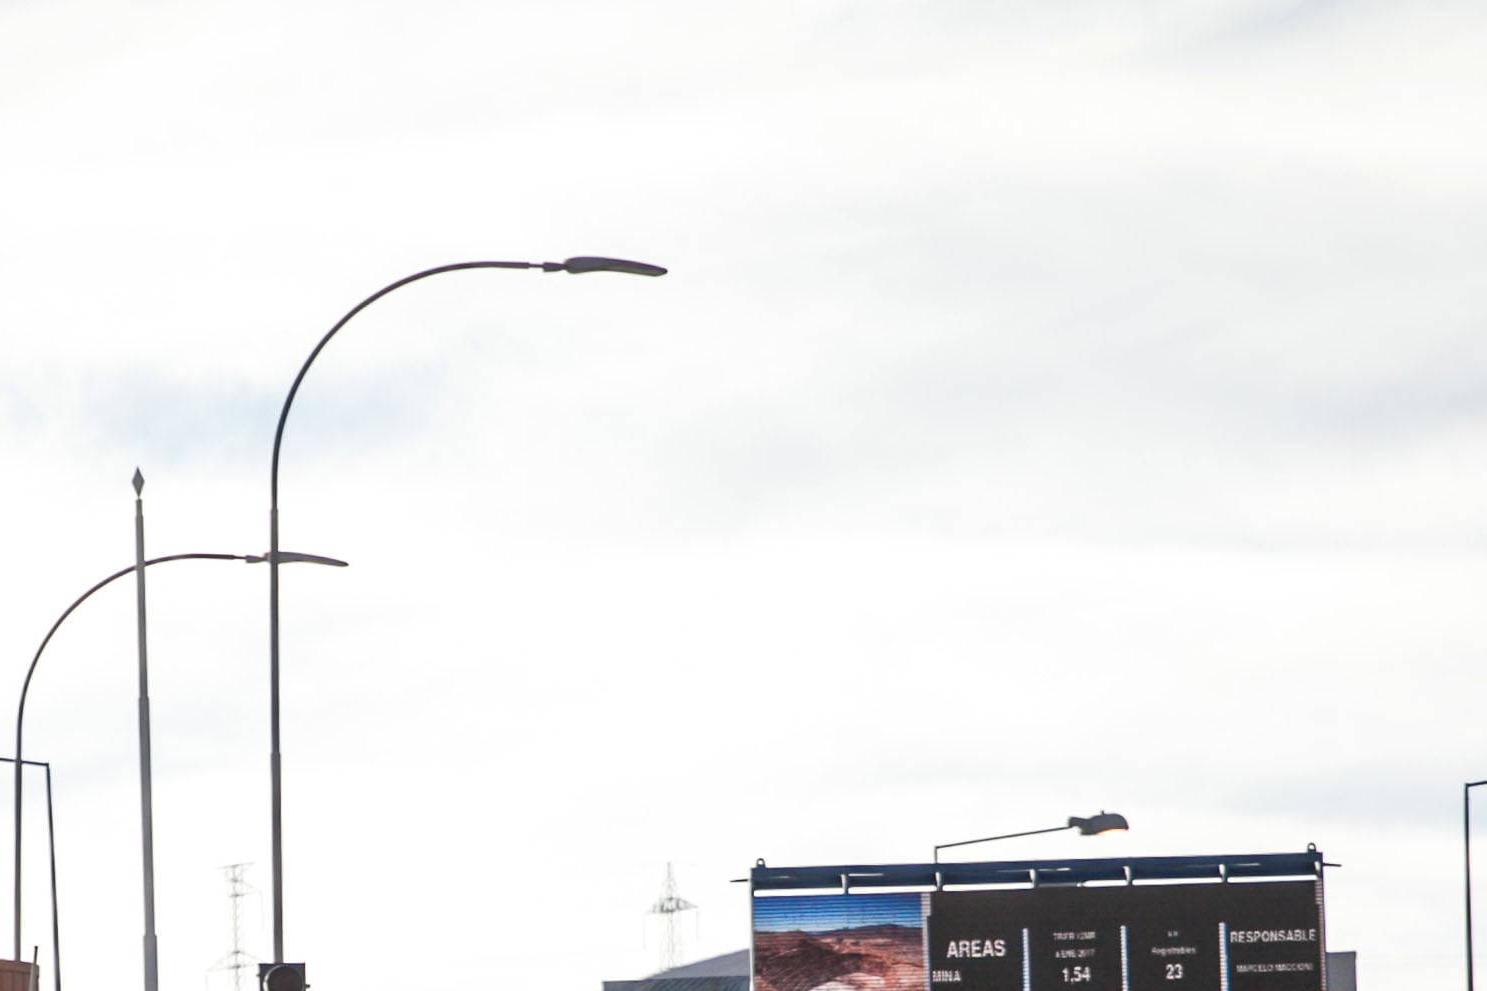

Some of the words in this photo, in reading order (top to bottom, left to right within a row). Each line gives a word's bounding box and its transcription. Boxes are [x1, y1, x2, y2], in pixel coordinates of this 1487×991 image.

[1230, 929, 1317, 943] RESPONSABLE
[946, 939, 1006, 958] AREAS
[932, 970, 961, 982] MINA
[1165, 963, 1183, 980] 23
